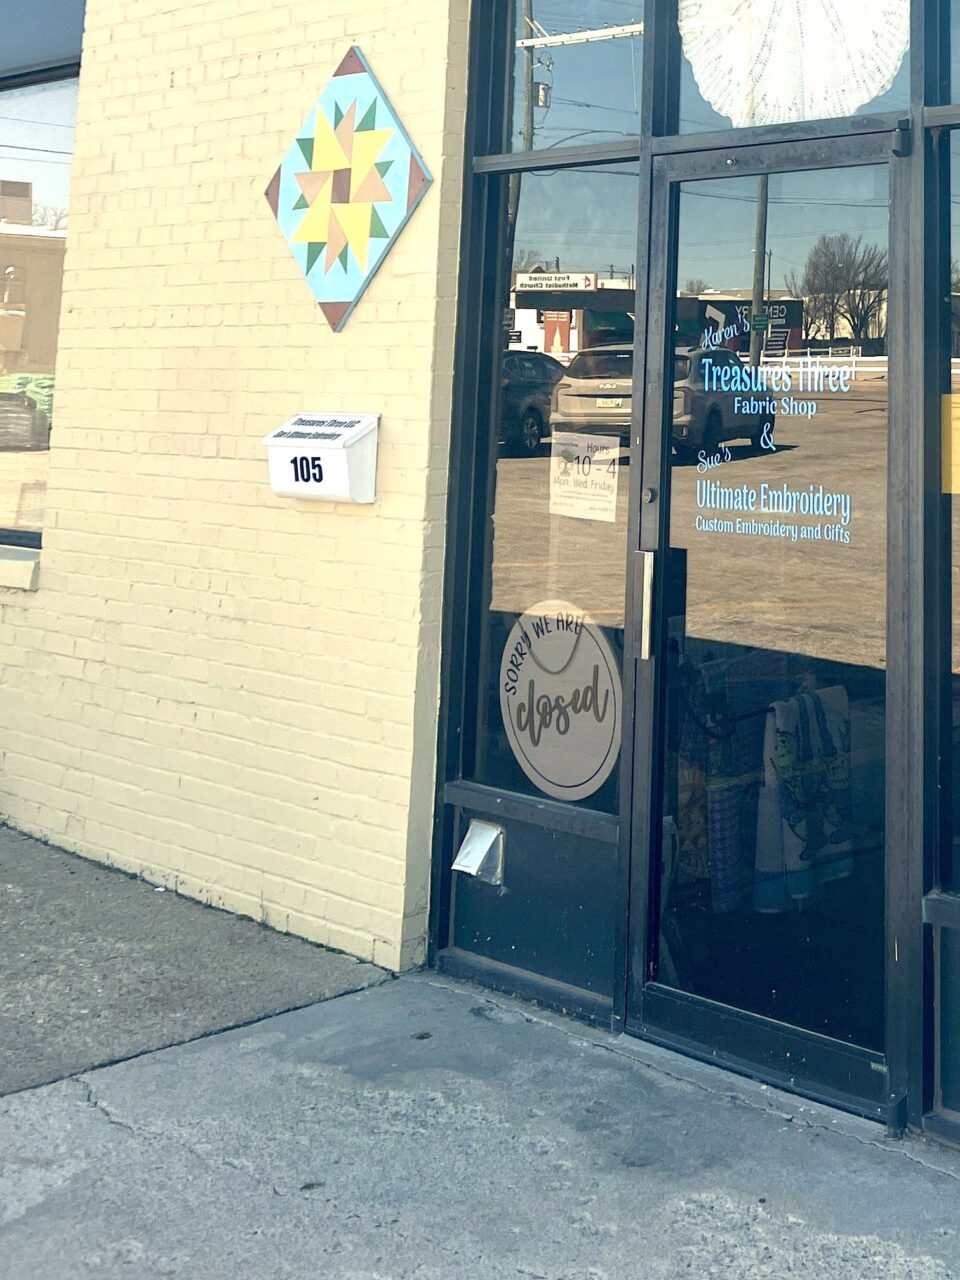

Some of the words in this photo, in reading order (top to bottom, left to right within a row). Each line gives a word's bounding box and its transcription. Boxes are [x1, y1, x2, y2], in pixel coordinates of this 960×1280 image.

[701, 314, 750, 350] Karen's
[701, 358, 791, 392] Treasures
[798, 360, 850, 392] Three
[733, 397, 777, 415] Fabric
[781, 397, 816, 419] Shop
[586, 441, 610, 455] Hours
[760, 422, 776, 451] &
[290, 456, 324, 483] 105
[574, 455, 592, 477] 10
[606, 458, 617, 479] 4
[697, 444, 731, 473] Sue's
[696, 480, 757, 511] Ultimate
[760, 483, 850, 525] Embroidery
[695, 515, 733, 533] Custom
[736, 518, 798, 542] Embroidery
[800, 523, 822, 540] and
[823, 523, 850, 543] Gifts
[504, 631, 532, 696] SORRY
[532, 614, 553, 639] WE
[556, 611, 582, 636] ARE
[516, 664, 610, 747] closed
